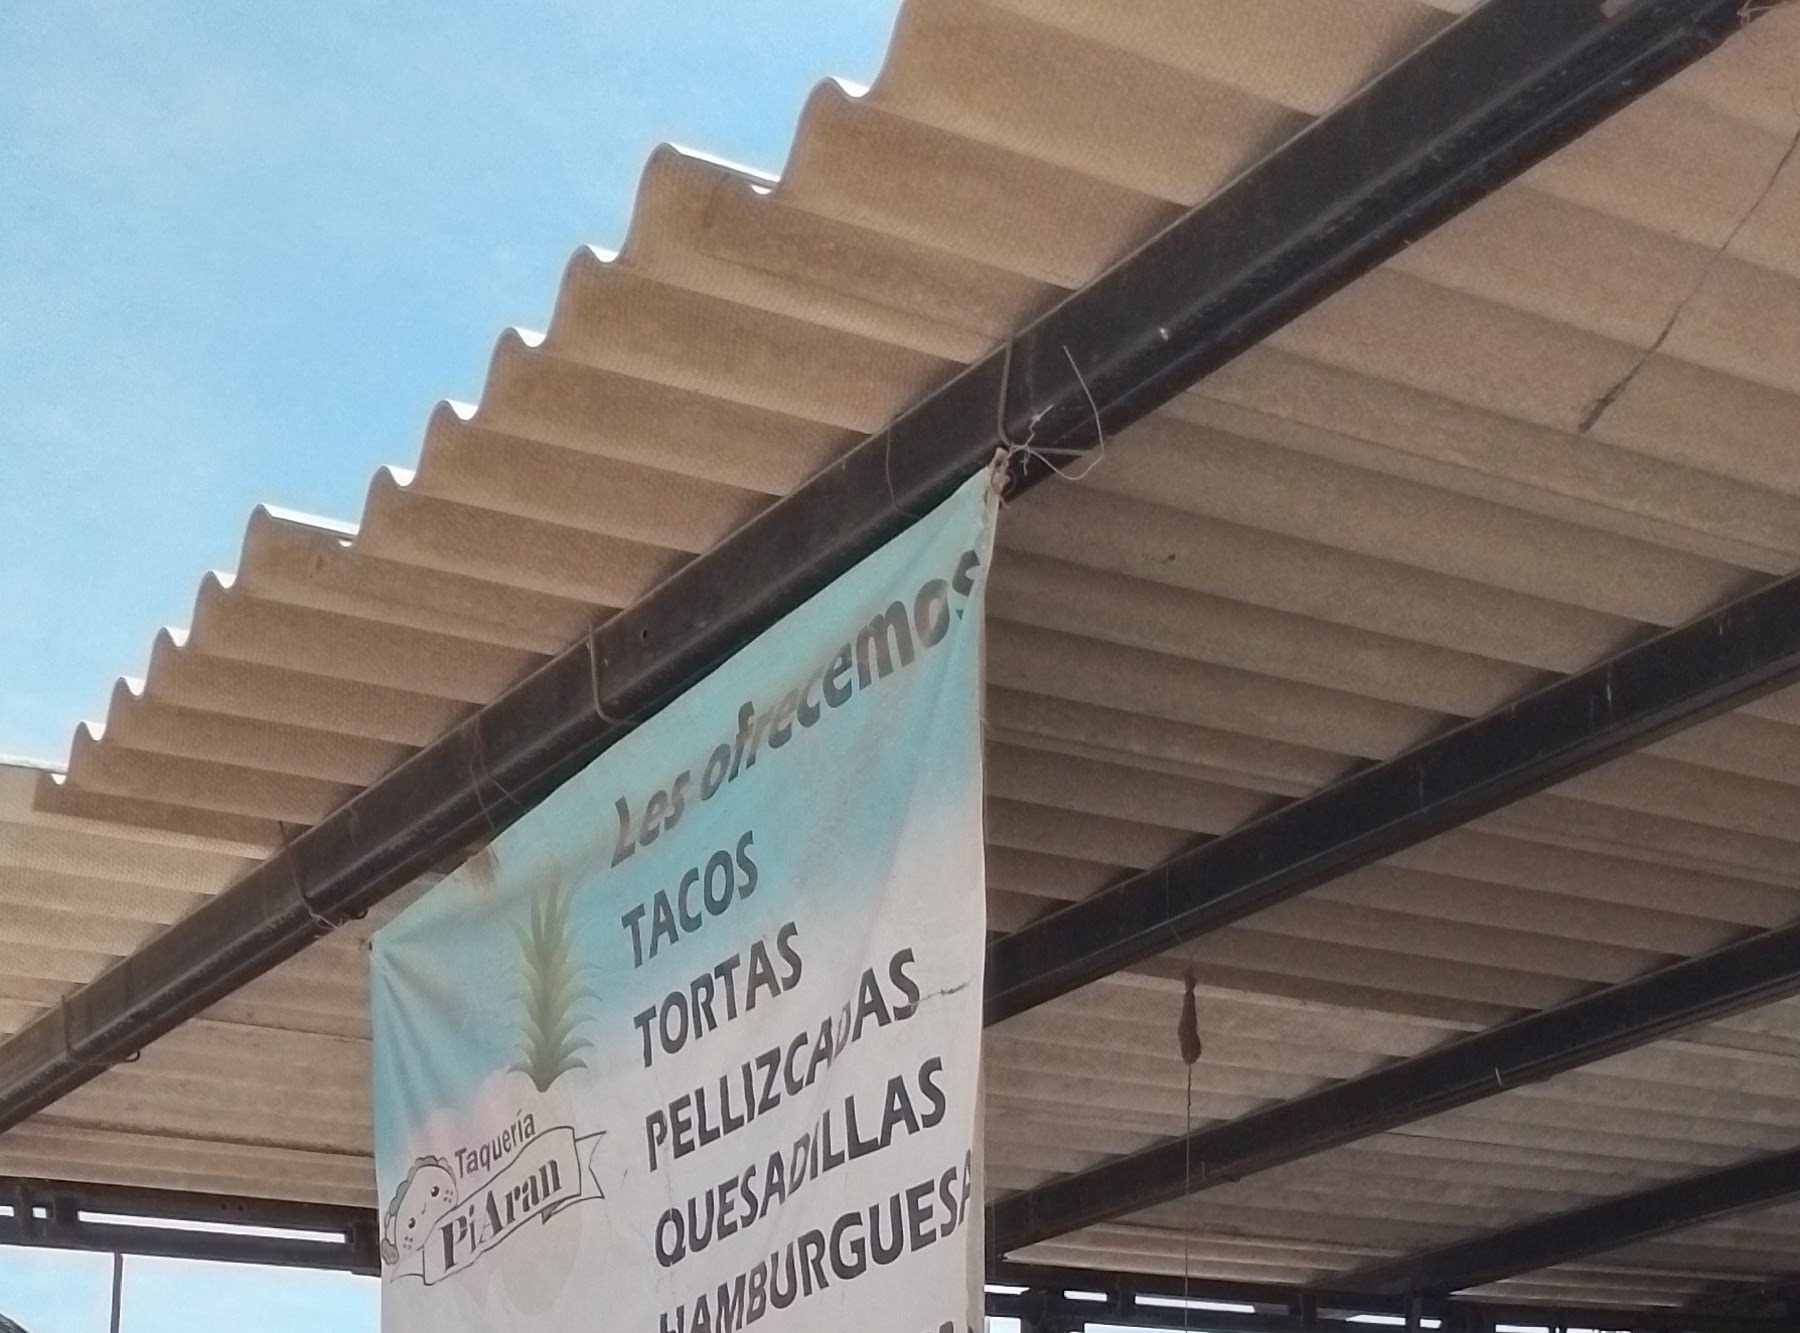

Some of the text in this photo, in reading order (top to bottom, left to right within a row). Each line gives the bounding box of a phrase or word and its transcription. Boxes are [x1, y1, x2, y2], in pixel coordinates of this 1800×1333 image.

[611, 549, 981, 869] Les ofrecemos
[622, 831, 759, 968] TACOS
[634, 921, 803, 1069] TORTAS
[645, 948, 920, 1171] PELLIZCADAS
[439, 1160, 562, 1273] PiAran
[455, 1109, 536, 1178] Taquería
[655, 1057, 947, 1267] QUESADILLAS
